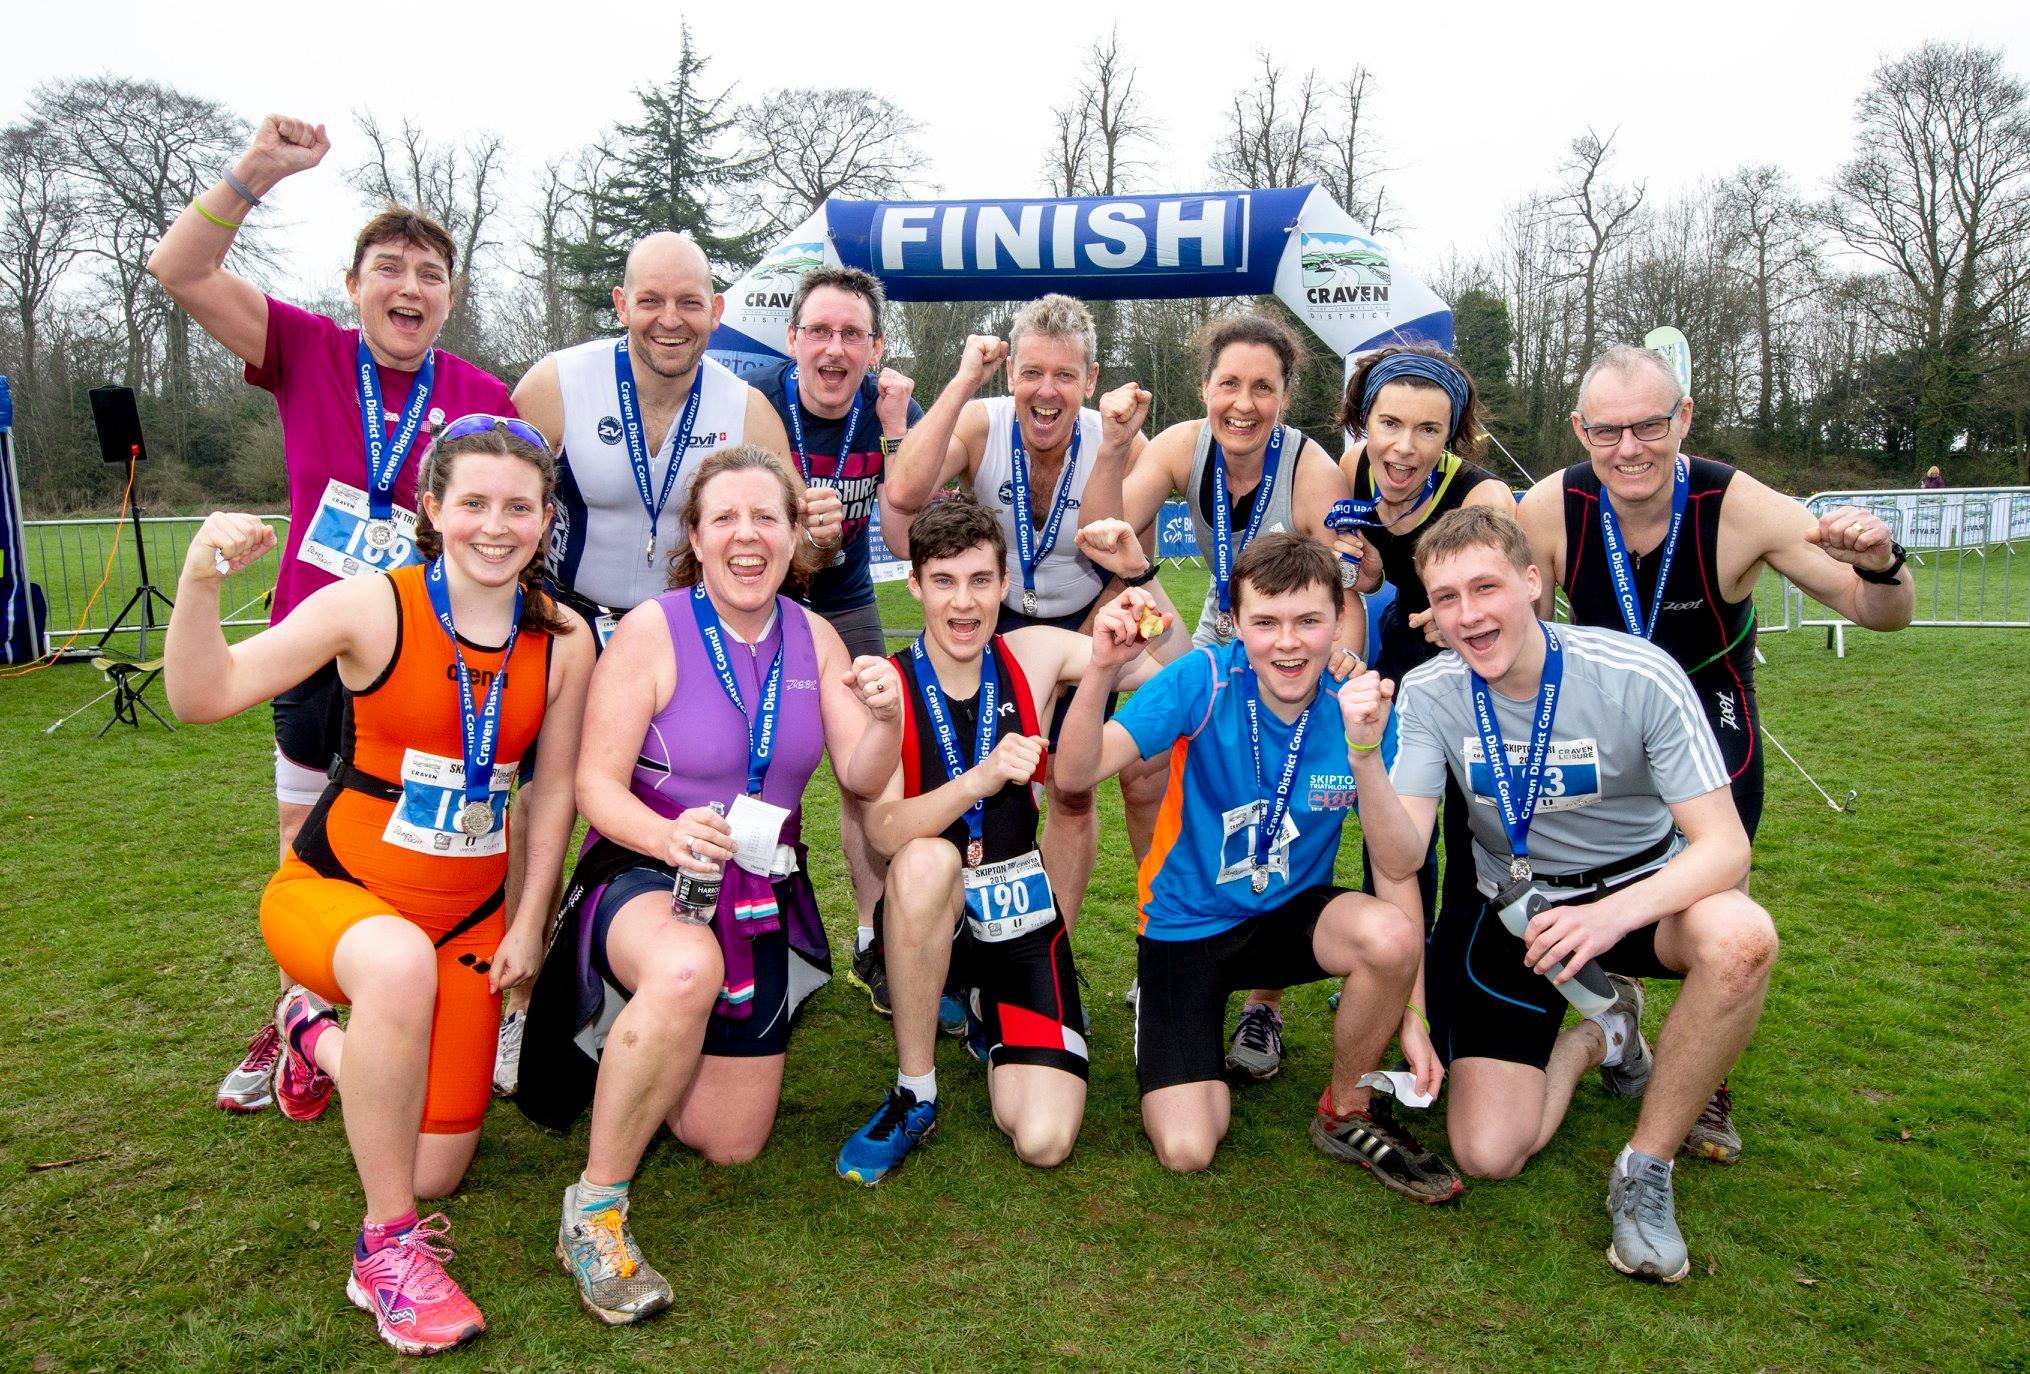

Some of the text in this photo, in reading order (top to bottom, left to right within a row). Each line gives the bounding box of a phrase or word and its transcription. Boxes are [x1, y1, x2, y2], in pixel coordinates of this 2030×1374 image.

[881, 199, 1227, 270] FINISH
[744, 292, 794, 308] CRAV
[1306, 286, 1389, 304] CRAVEN
[1310, 312, 1390, 320] DISTRICT
[361, 363, 373, 397] Craven
[366, 399, 380, 439] District
[377, 383, 428, 491] Craven District Council
[789, 404, 802, 440] Council
[620, 381, 652, 505] Craven District Council
[659, 392, 699, 509] Craven District Council
[835, 407, 860, 479] District Council
[1676, 456, 1685, 482] Crav
[1014, 448, 1031, 561] Craven District Council
[1049, 499, 1065, 534] District
[1062, 461, 1076, 497] Council
[1256, 475, 1273, 513] Council
[1215, 467, 1229, 582] Craven District Council
[1603, 512, 1641, 636] Craven District Council
[1657, 556, 1671, 599] District
[1667, 512, 1681, 555] Council
[459, 661, 473, 710] District
[704, 626, 747, 714] District Council
[763, 669, 780, 712] District
[926, 684, 944, 723] Craven
[939, 725, 958, 765] District
[983, 682, 994, 724] Council
[1247, 700, 1259, 743] Council
[476, 719, 494, 766] Craven
[757, 714, 774, 758] Craven
[1521, 684, 1556, 820] Craven District Council
[1558, 746, 1593, 754] CRAVEN
[1558, 752, 1594, 760] LEISURE
[411, 769, 438, 780] CRAVEN
[1266, 709, 1310, 836] Craven District Council
[1310, 774, 1354, 785] SKIPTO
[1476, 692, 1517, 825] Craven District Council
[975, 865, 1007, 878] SKIPTON
[980, 881, 1029, 920] 190
[1648, 1164, 1666, 1174] NIKE
